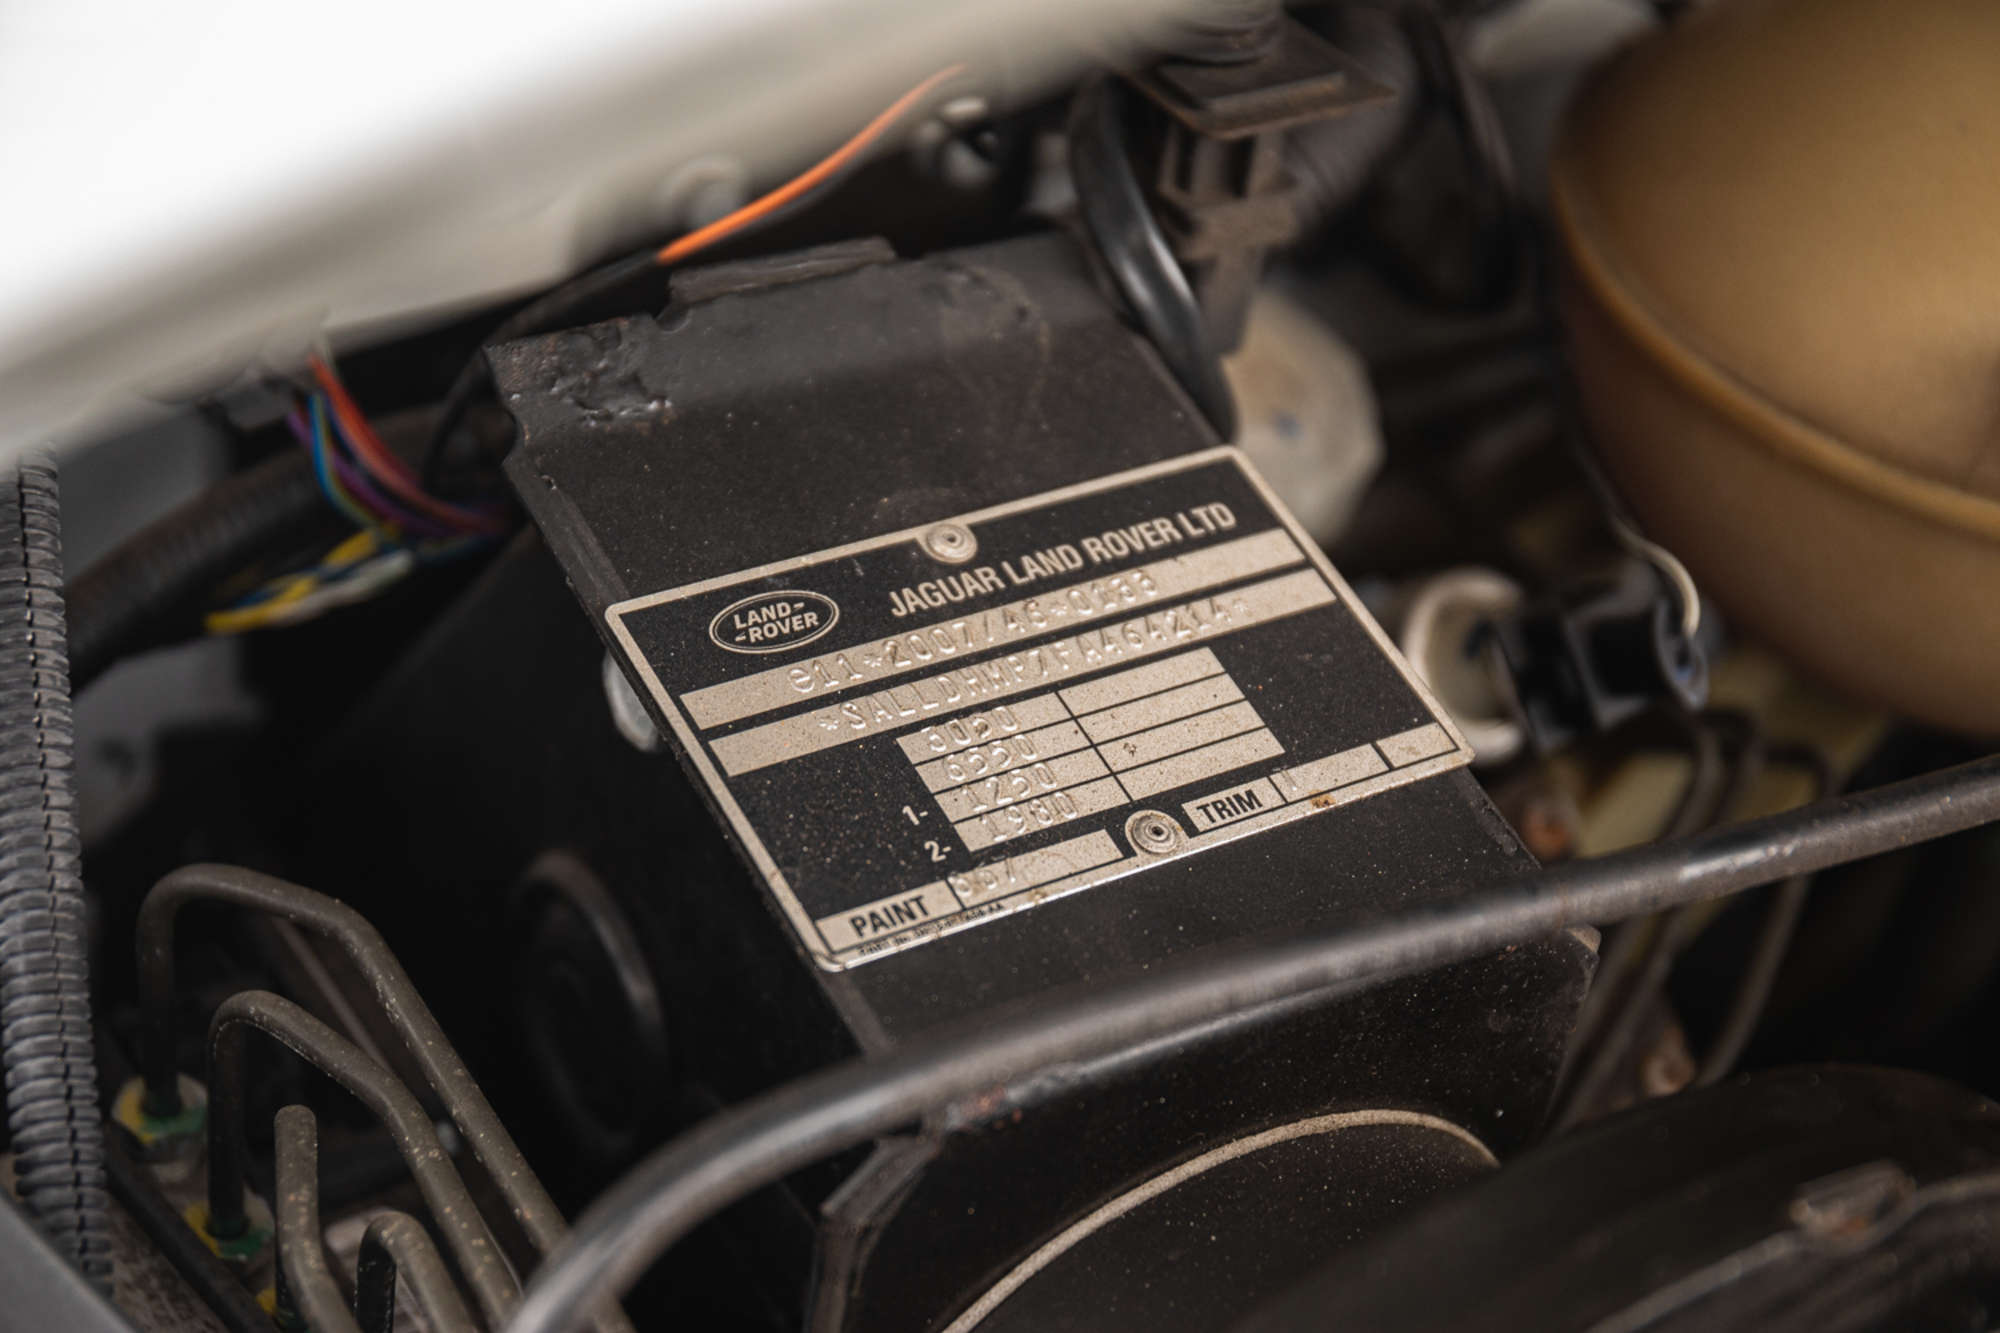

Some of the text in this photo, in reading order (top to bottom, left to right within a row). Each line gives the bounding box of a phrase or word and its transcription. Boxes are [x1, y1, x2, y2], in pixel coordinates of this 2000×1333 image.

[889, 502, 1237, 617] JAGUAR LAND ROVER LTD
[902, 762, 1058, 825] 1- 1250
[1197, 789, 1264, 824] TRIM
[924, 790, 1079, 862] 2- 1980
[850, 895, 929, 937] PAINT
